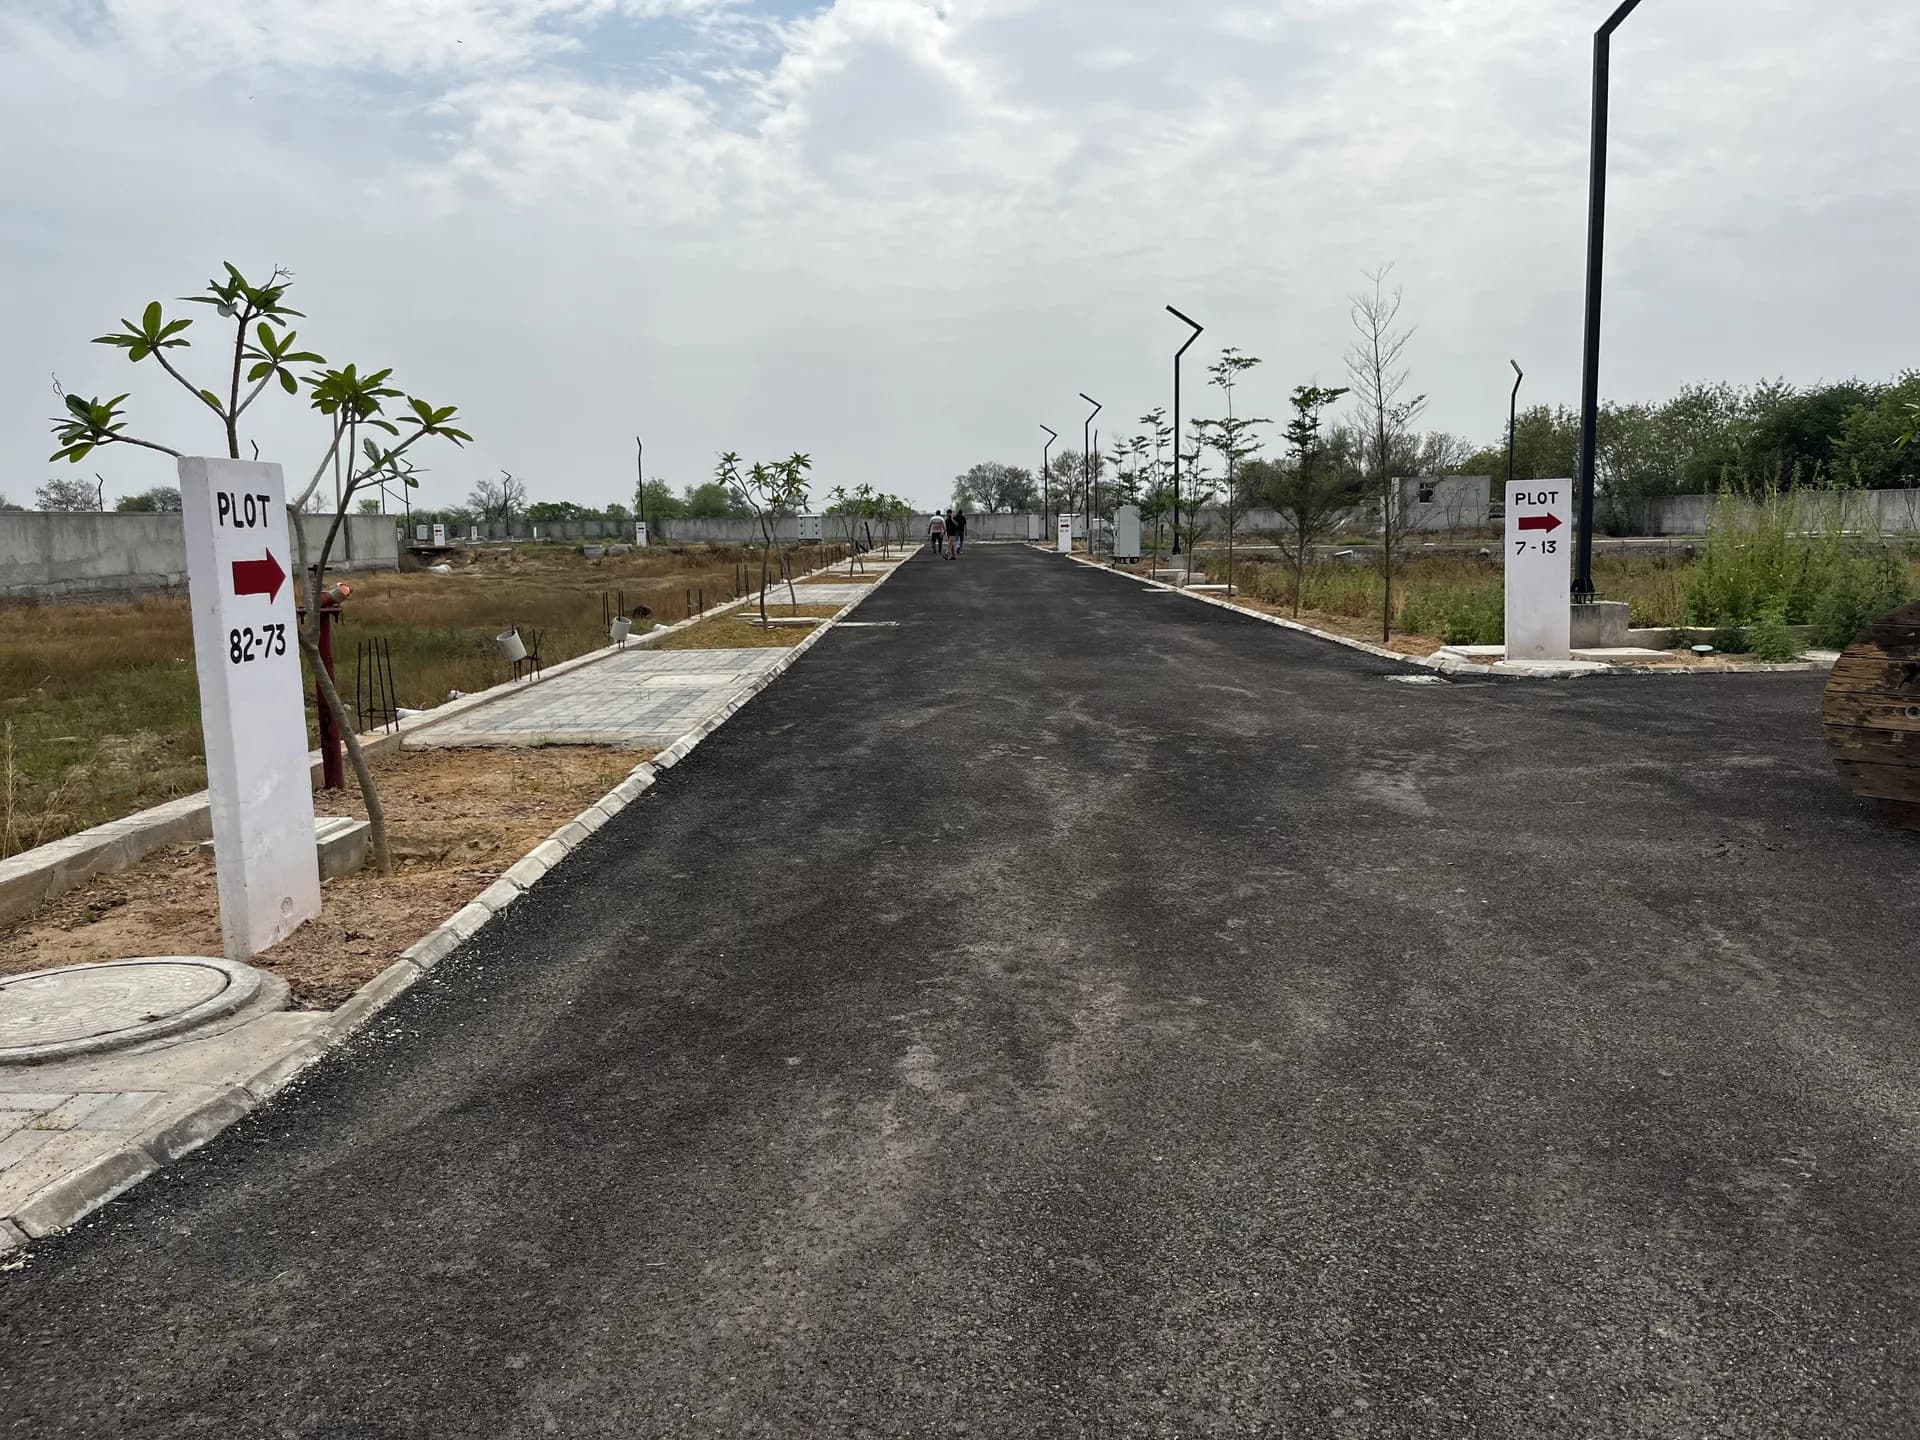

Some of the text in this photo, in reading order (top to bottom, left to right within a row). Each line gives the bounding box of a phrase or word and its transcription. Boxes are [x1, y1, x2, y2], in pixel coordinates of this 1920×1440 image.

[217, 491, 271, 529] PLOT
[1515, 491, 1559, 506] PLOT
[229, 623, 286, 665] 82-73
